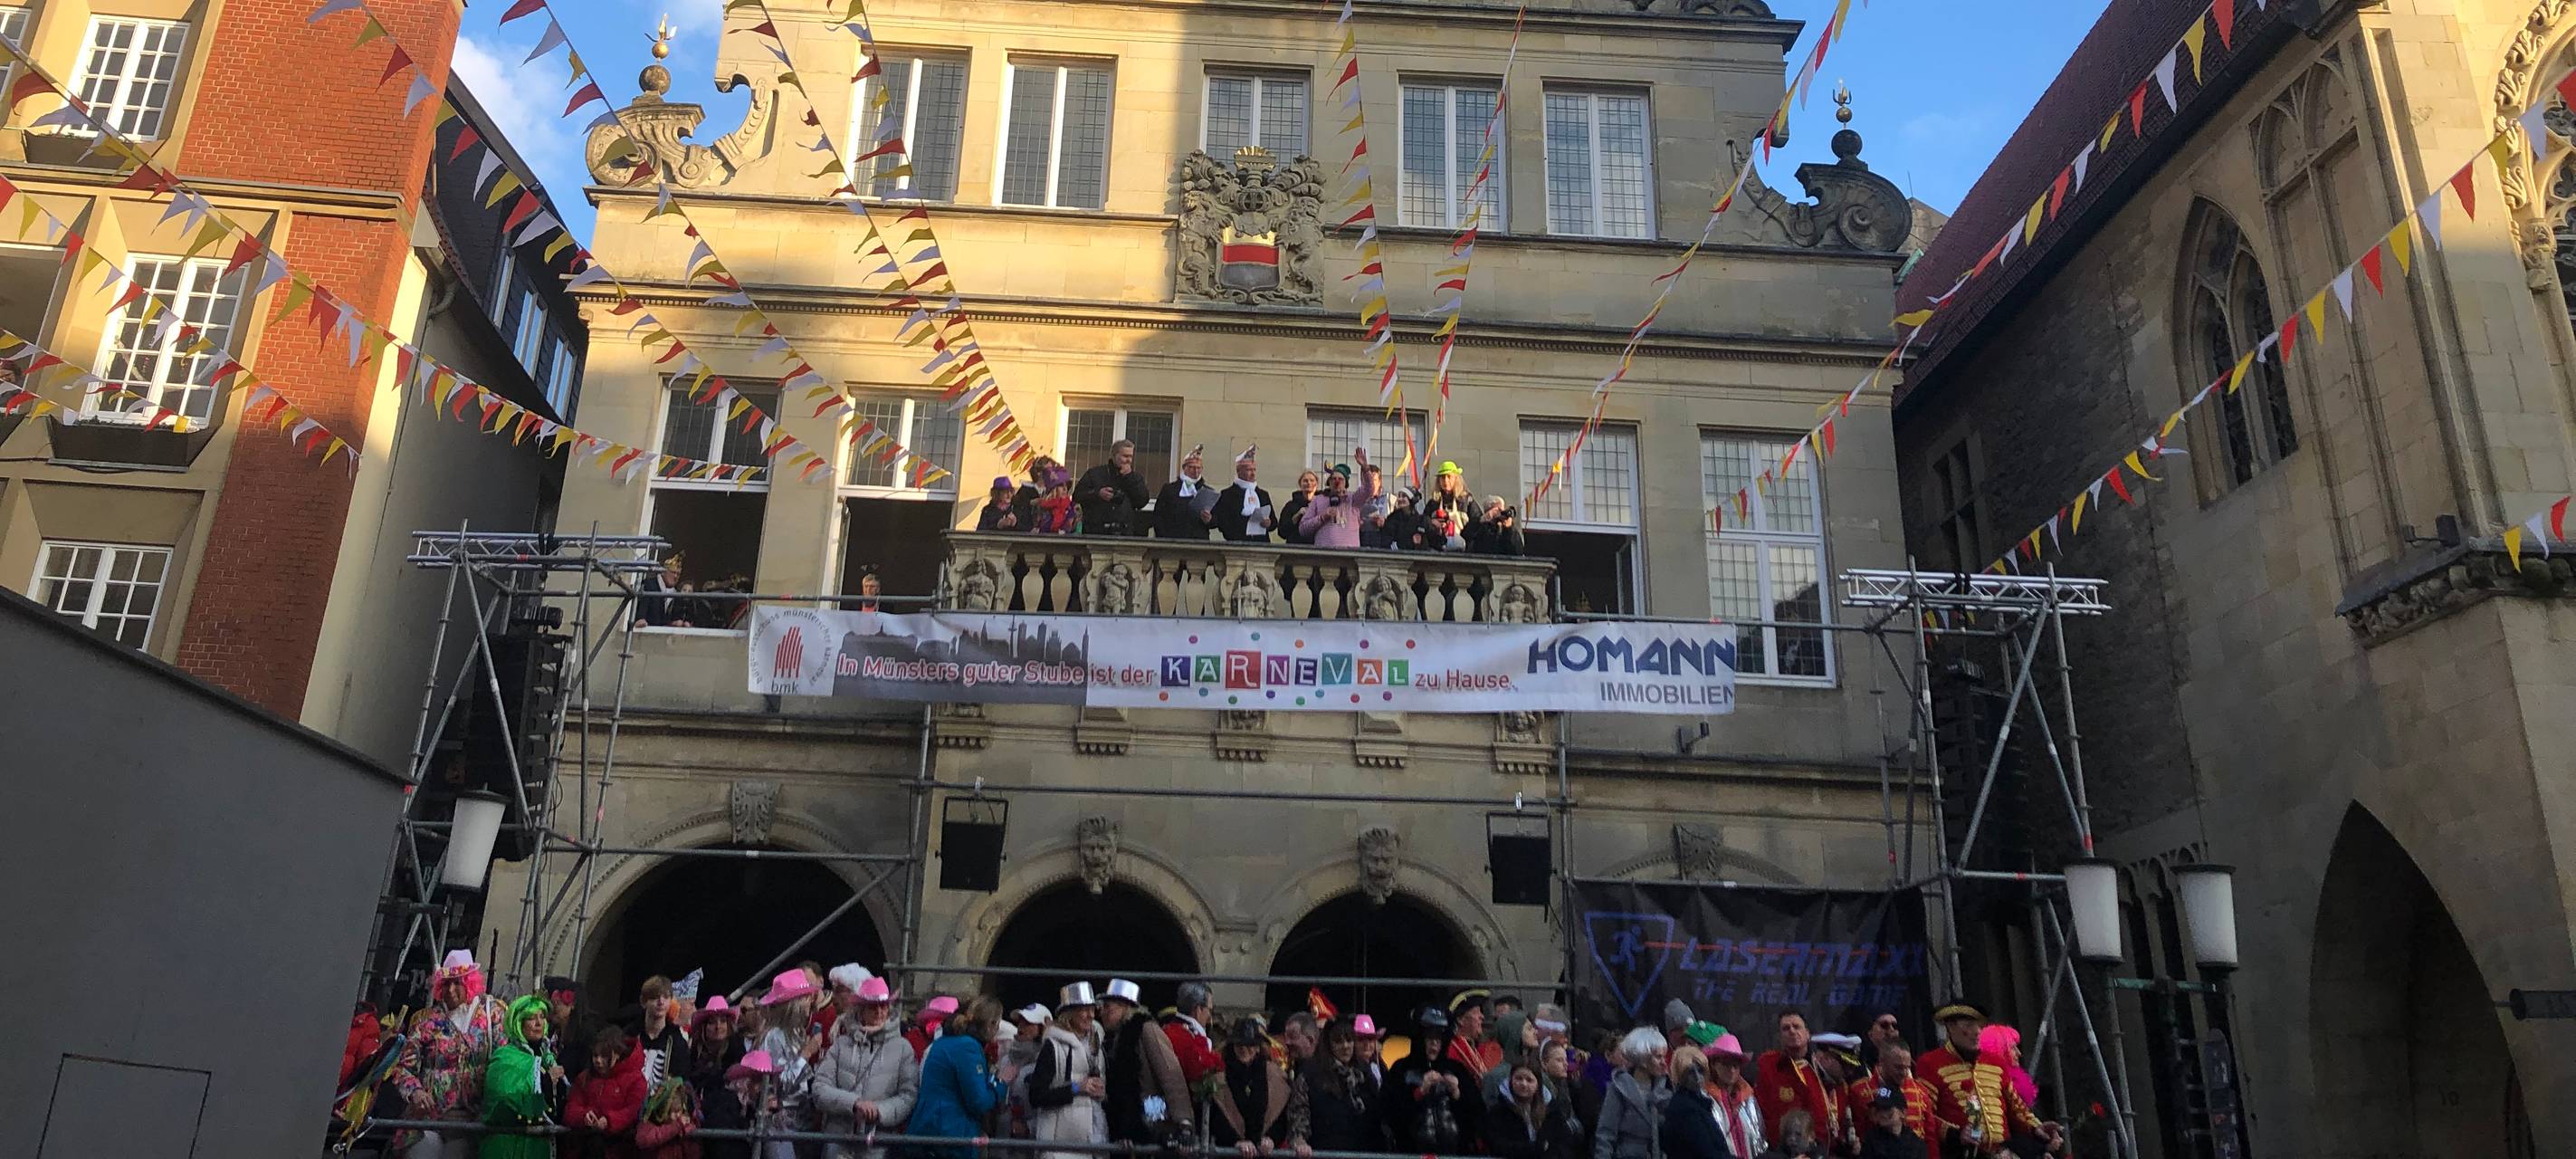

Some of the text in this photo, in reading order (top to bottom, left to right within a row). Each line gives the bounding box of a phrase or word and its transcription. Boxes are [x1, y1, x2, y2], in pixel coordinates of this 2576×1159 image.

[1527, 636, 1735, 675] HOMANN
[837, 653, 858, 675] In
[863, 656, 959, 681] Münsters
[963, 660, 1022, 687] guter
[1024, 660, 1085, 685] Stube
[1091, 663, 1116, 685] ist
[1121, 664, 1155, 685] der
[1162, 651, 1409, 689] KARNEVAL
[1415, 673, 1440, 691] zu
[771, 680, 799, 694] bmk
[1600, 681, 1733, 705] IMMOBILIEN
[1694, 978, 1738, 1001] THE
